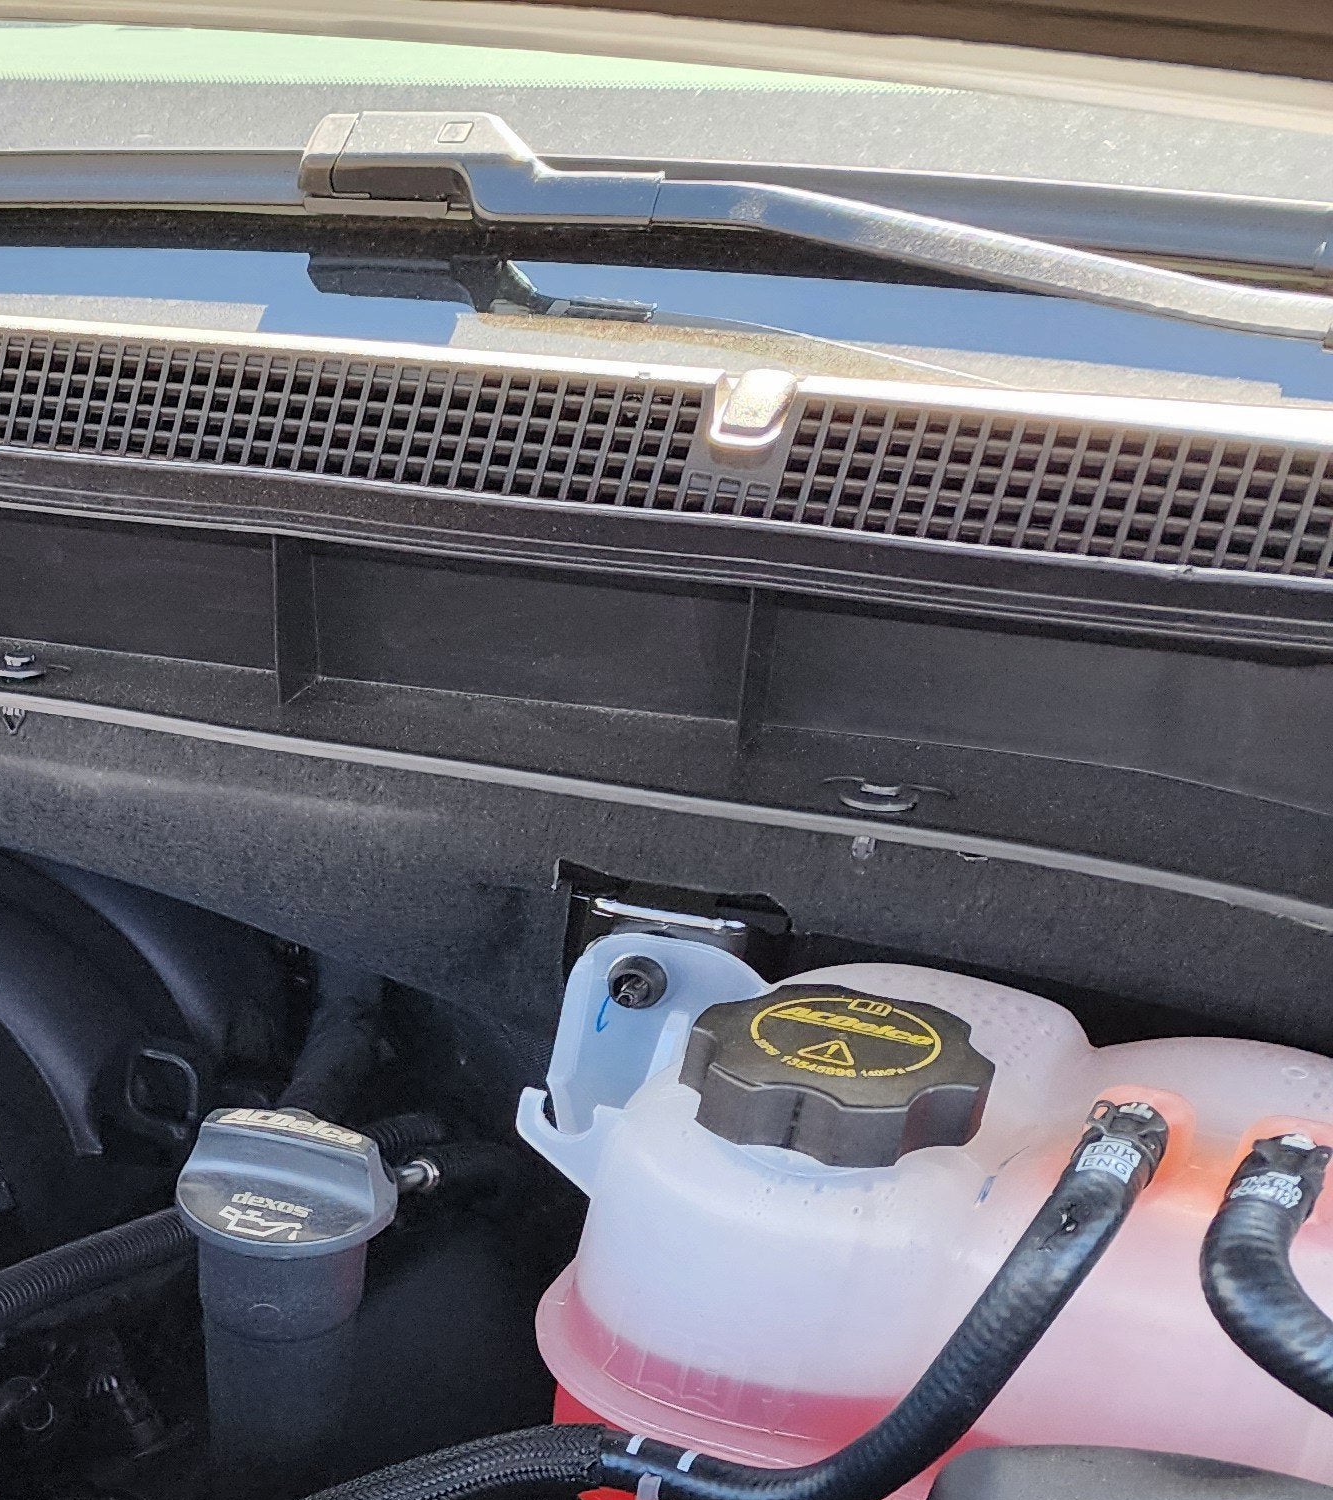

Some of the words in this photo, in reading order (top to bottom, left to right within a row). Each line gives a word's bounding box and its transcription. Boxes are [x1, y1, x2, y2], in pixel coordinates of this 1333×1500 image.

[217, 1107, 364, 1148] ACDelco
[1089, 1144, 1136, 1163] TNK
[1082, 1157, 1130, 1176] ENG
[231, 1191, 314, 1219] dexos
